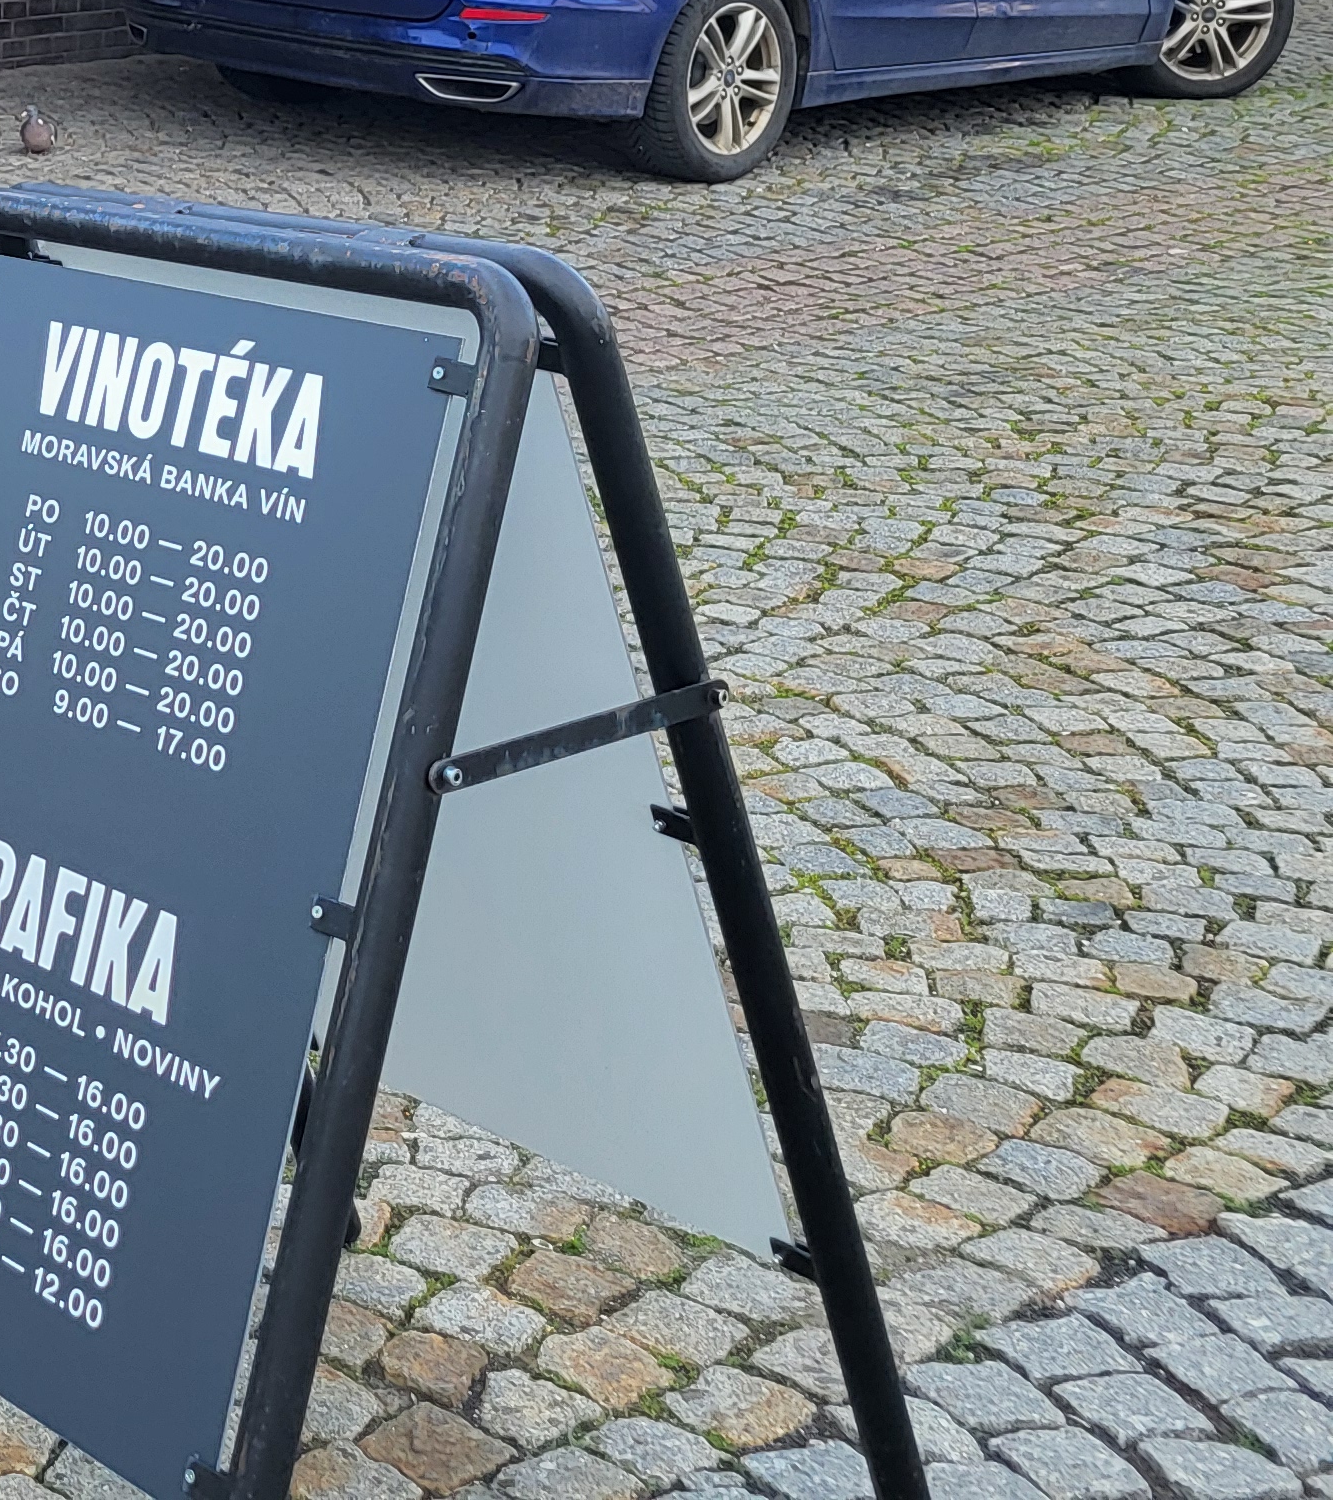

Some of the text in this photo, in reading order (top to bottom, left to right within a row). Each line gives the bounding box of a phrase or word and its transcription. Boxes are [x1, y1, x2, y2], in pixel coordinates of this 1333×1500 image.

[39, 320, 324, 480] VINOTÉKA
[21, 429, 306, 524] MORAVSKÁ BANKA VÍN
[18, 523, 52, 558] ÚT
[77, 545, 142, 586] 10.00
[181, 576, 260, 621] 20.00
[25, 493, 60, 524] PO
[85, 510, 150, 550] 10.00
[189, 540, 269, 584] 20.00
[2, 590, 37, 627] ČT
[60, 615, 125, 657] 10.00
[164, 649, 243, 696] 20.00
[9, 562, 43, 592] ST
[68, 580, 134, 621] 10.00
[172, 613, 252, 659] 20.00
[52, 650, 117, 693] 10.00
[156, 686, 235, 734] 20.00
[52, 689, 109, 729] 9.00
[157, 725, 226, 772] 17.00
[77, 1074, 146, 1130] 16.00
[112, 1027, 221, 1099] NOVINY
[60, 1151, 128, 1209] 16.00
[69, 1113, 137, 1170] 16.00
[43, 1228, 111, 1288] 16.00
[51, 1189, 119, 1248] 16.00
[34, 1266, 103, 1328] 12.00
